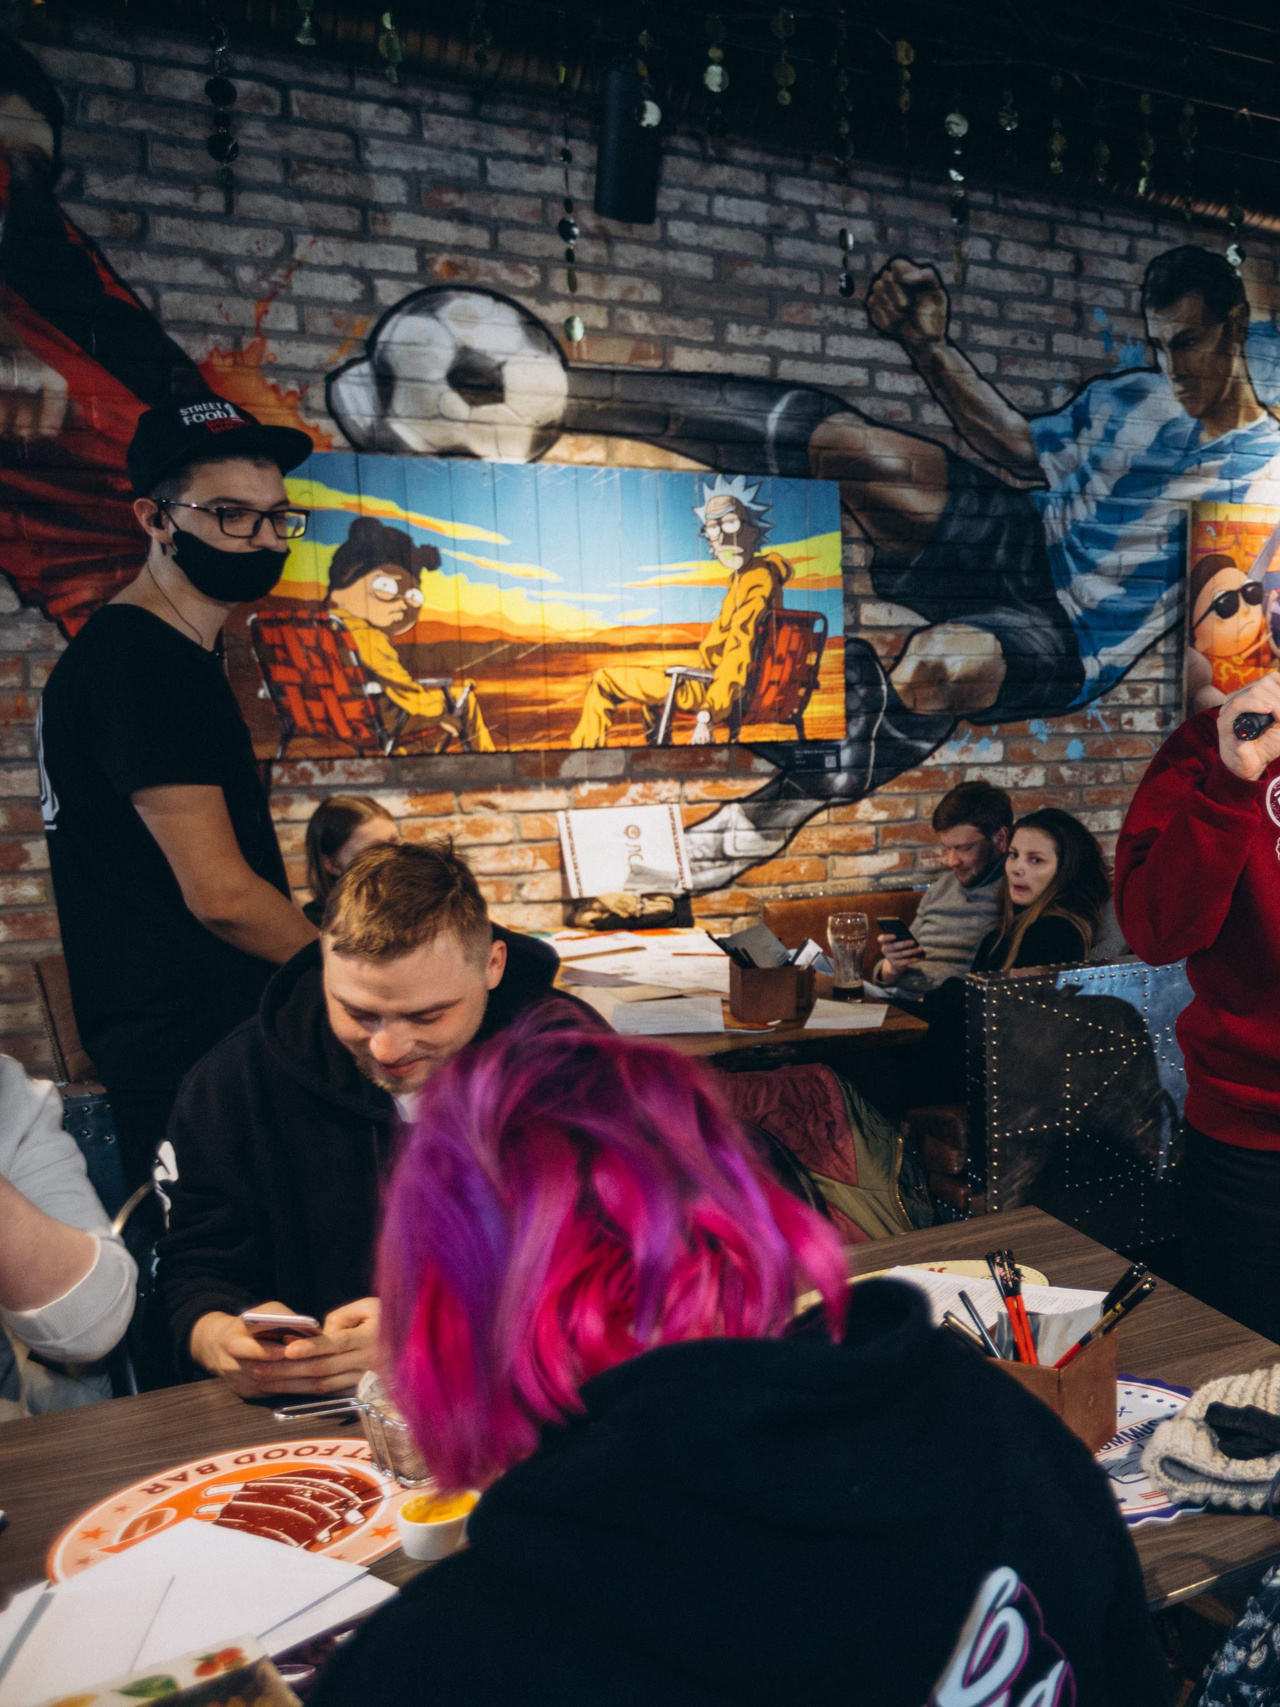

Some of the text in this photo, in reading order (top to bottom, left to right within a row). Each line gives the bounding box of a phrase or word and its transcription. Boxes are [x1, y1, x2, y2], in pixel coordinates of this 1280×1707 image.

[180, 402, 222, 416] STREET
[183, 410, 228, 426] FOOD
[233, 1445, 342, 1465] FOOD
[139, 1463, 220, 1495] BAR
